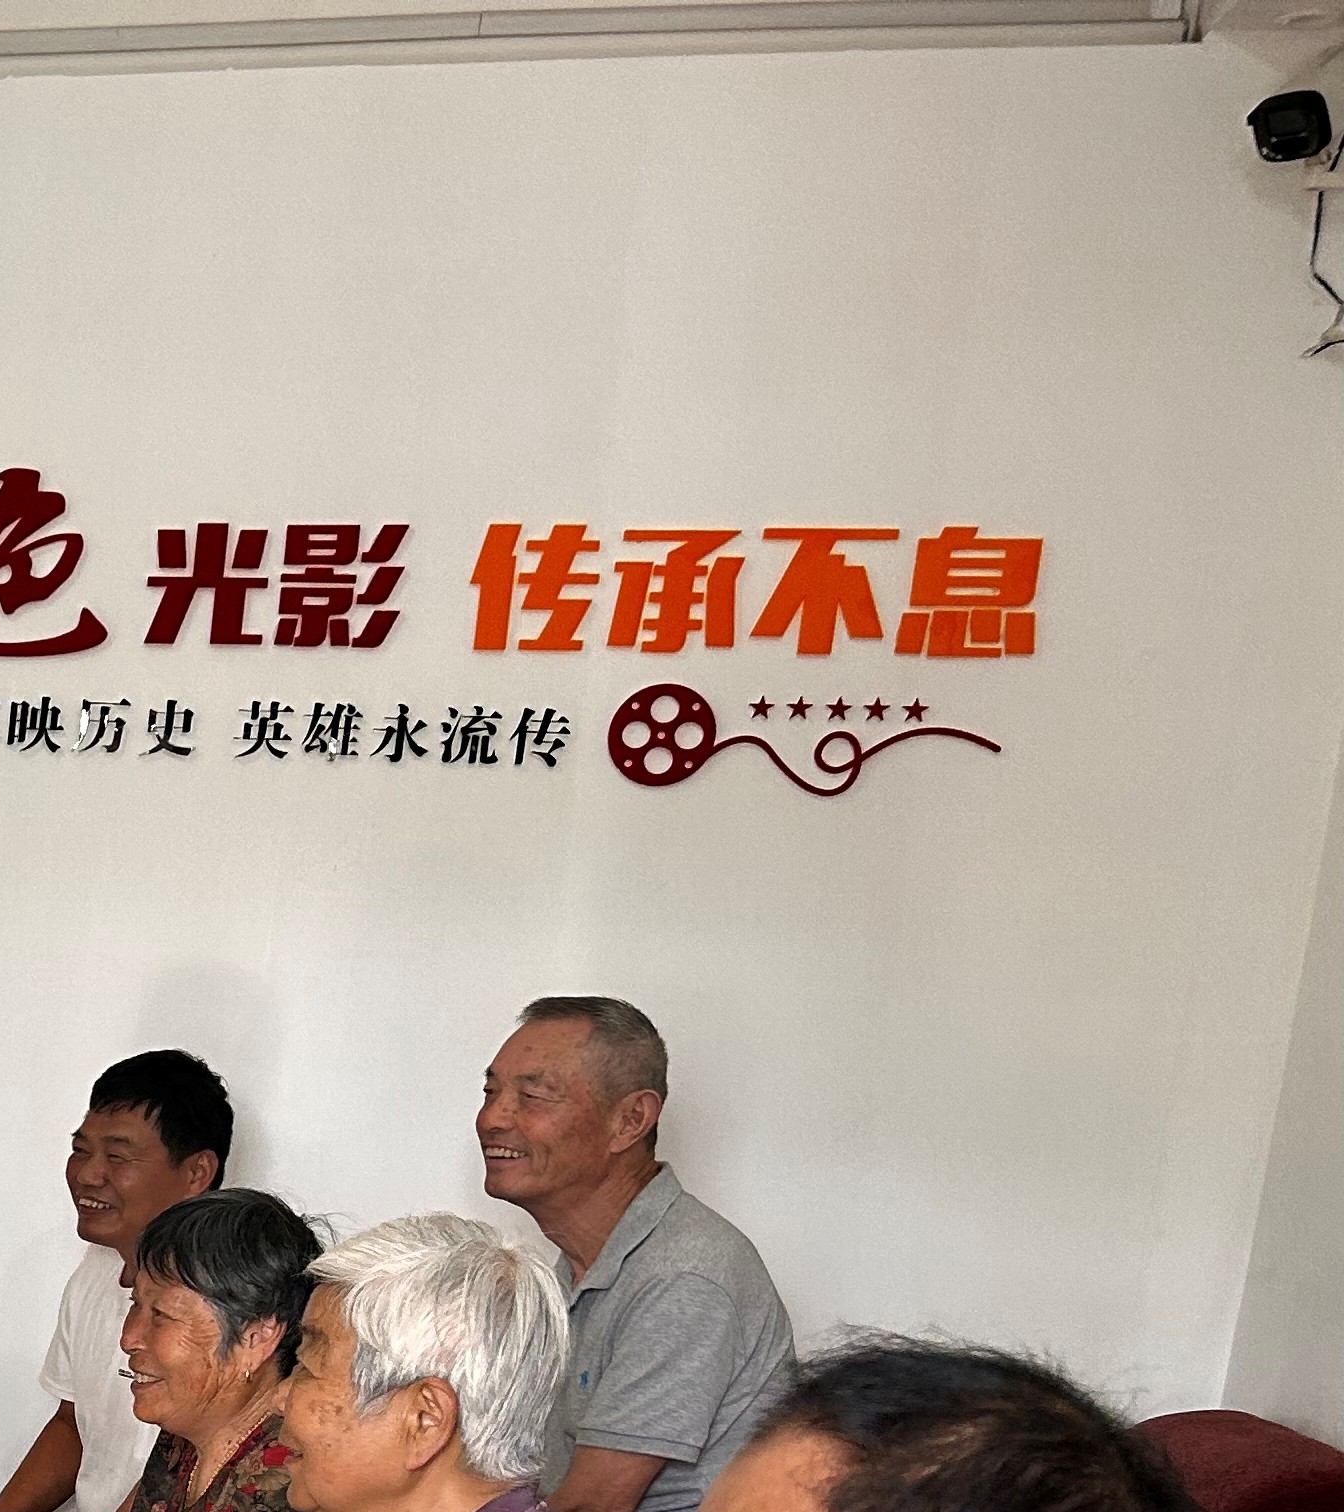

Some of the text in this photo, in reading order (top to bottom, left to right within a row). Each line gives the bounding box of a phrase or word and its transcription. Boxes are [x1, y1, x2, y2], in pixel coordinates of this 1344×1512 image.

[469, 521, 1044, 659] 传承不息
[234, 702, 572, 768] 英雄永流传
